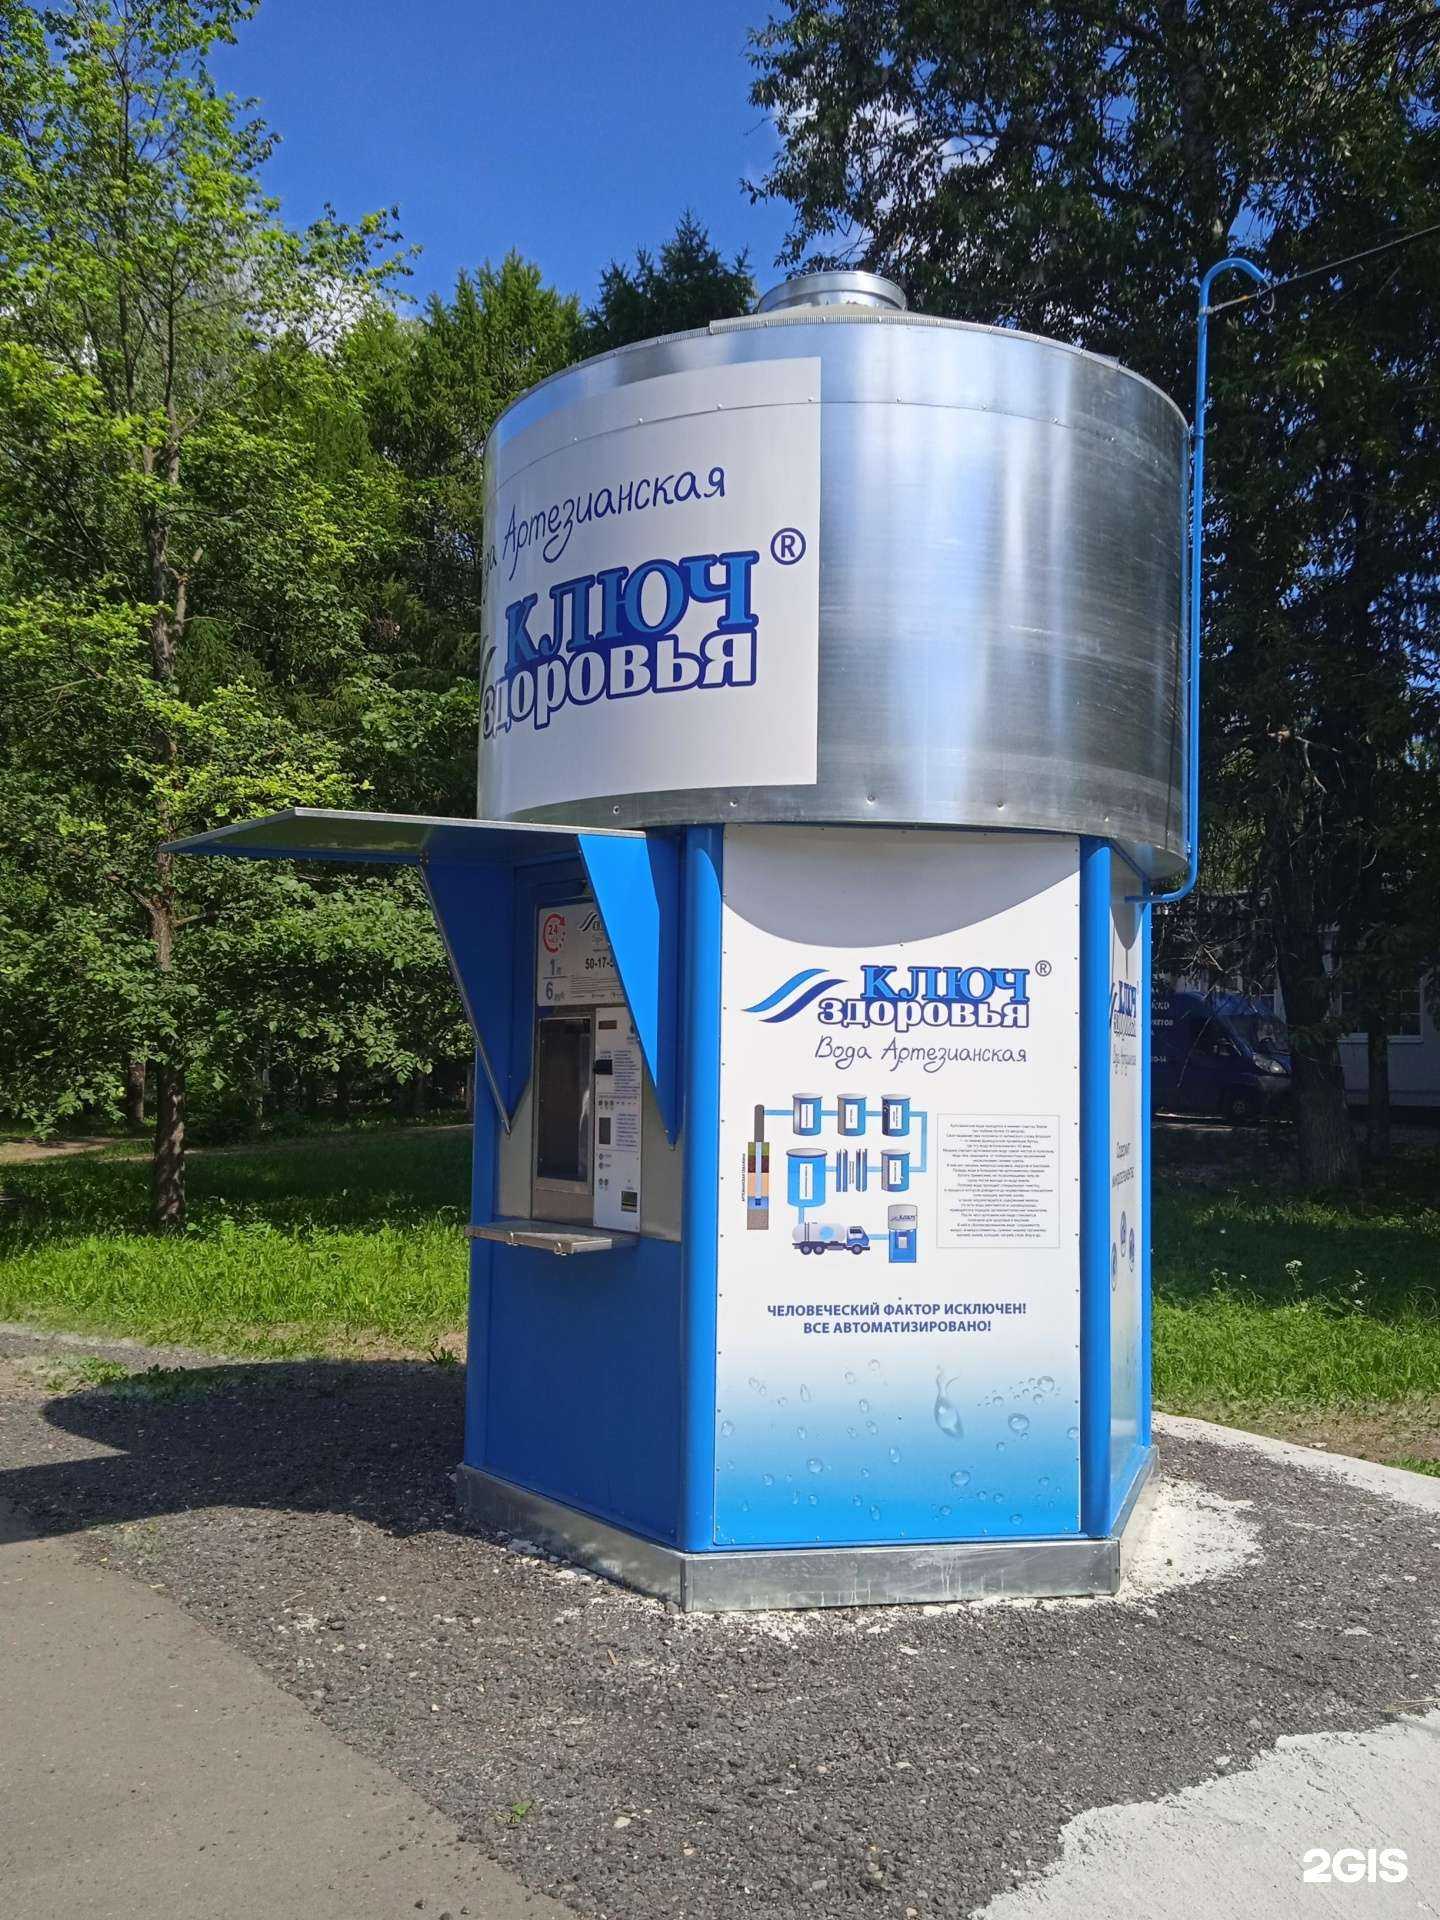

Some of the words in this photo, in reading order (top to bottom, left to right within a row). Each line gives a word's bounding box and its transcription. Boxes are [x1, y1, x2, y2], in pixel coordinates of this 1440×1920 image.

[503, 466, 725, 581] Артезианская
[860, 965, 1030, 1002] КЛЮЧ
[818, 997, 1030, 1033] здоровья
[814, 1035, 872, 1070] Вода
[881, 1036, 1027, 1073] Артезианская
[767, 1302, 880, 1317] ЧЕЛОВЕЧЕСКИЙ
[883, 1304, 941, 1316] ФАКТОР
[944, 1303, 1027, 1316] ИСКЛЮЧЕН!
[803, 1322, 830, 1334] ВСЕ
[833, 1320, 992, 1333] АВТОМАТИЗИРОВАНО!
